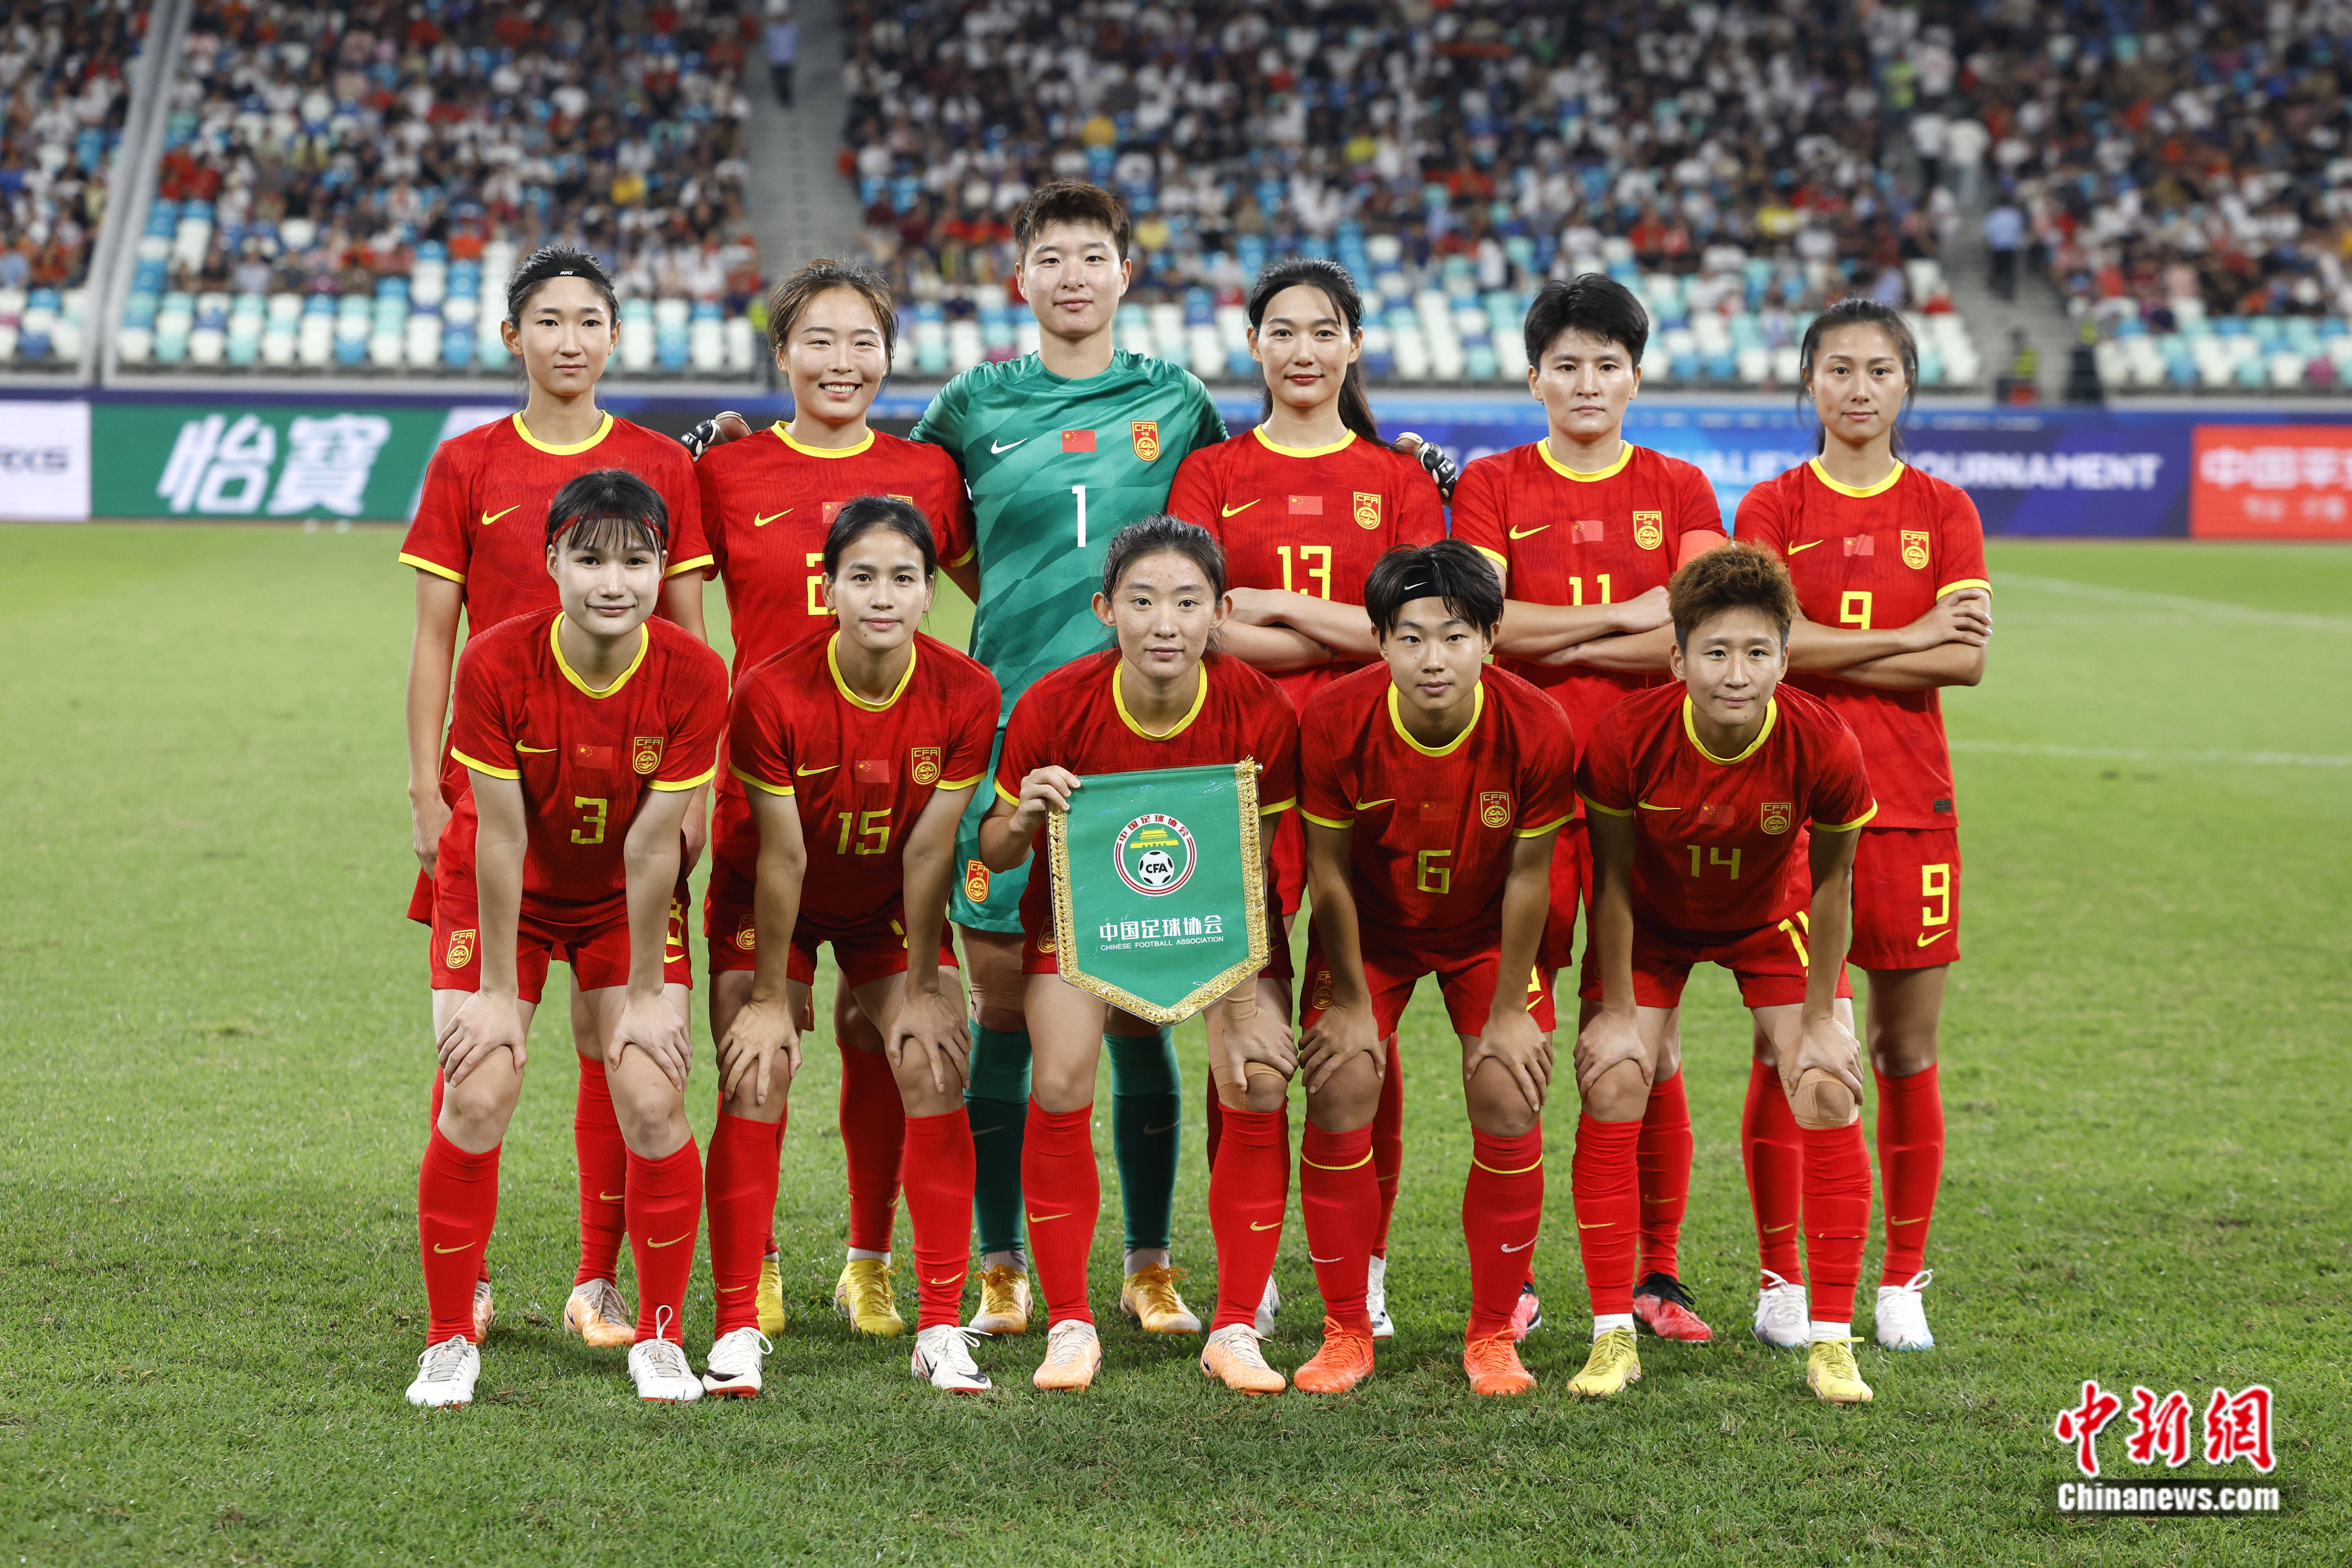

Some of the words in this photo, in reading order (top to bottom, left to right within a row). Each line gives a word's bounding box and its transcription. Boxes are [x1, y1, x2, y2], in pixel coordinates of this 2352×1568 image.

[157, 414, 390, 516] 怡寶
[1908, 450, 2163, 490] OURNAMENT
[2200, 445, 2352, 490] 中国平
[1071, 485, 1086, 547] 1
[1356, 494, 1378, 504] CFA
[1904, 533, 1926, 541] CFA
[1277, 545, 1332, 600] 13
[1569, 574, 1611, 606] 11
[1840, 591, 1873, 630] 9
[571, 796, 607, 844] 3
[837, 808, 892, 855] 15
[1119, 815, 1189, 841] 中国足球协会
[971, 863, 988, 873] CFA
[1145, 863, 1168, 873] CFA
[1417, 849, 1451, 894] 6
[1687, 845, 1741, 880] 14
[1922, 863, 1950, 926] 9
[453, 932, 473, 941] CFA
[1099, 915, 1223, 941] 中国足球协会
[1100, 943, 1132, 951] CHINESE
[1135, 940, 1173, 948] FOOTBALL
[1176, 936, 1224, 945] ASSOCIATION
